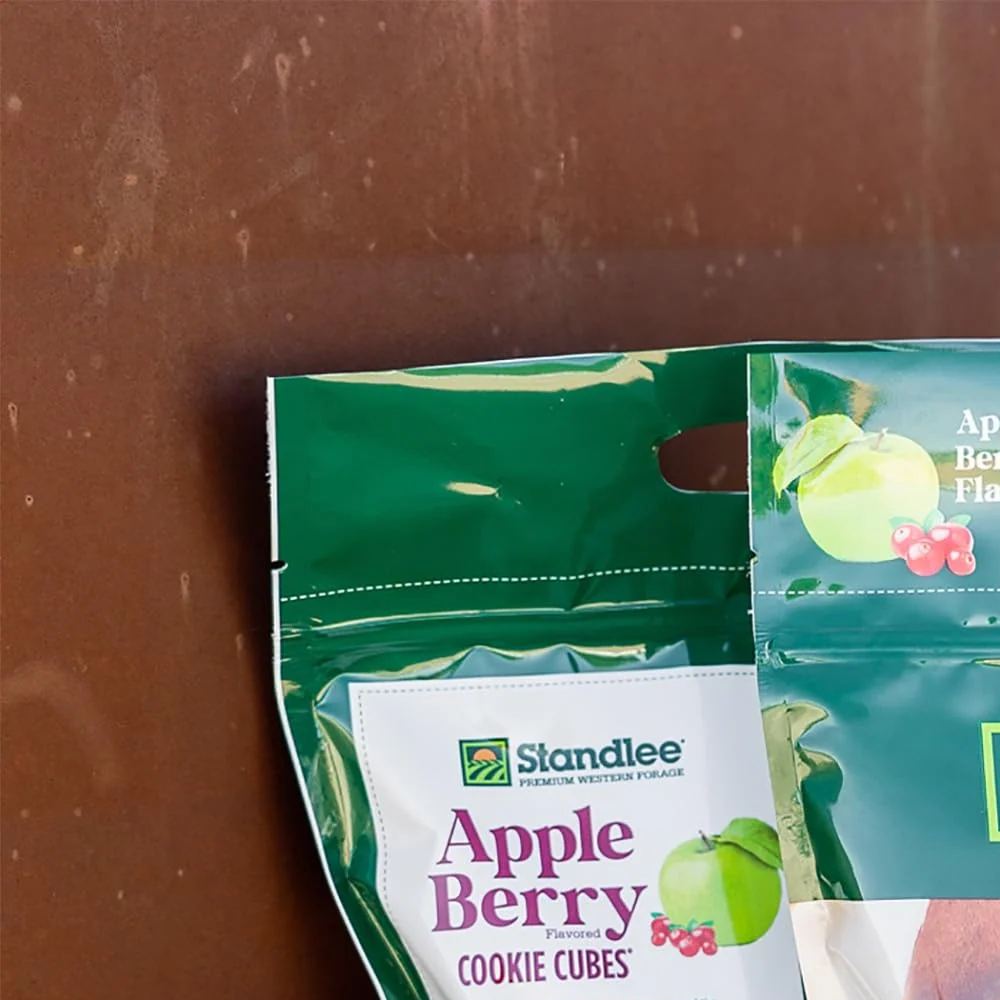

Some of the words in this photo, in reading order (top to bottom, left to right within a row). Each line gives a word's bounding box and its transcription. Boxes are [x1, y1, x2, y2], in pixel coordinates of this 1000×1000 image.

[519, 776, 576, 787] PREMIUM
[578, 772, 633, 784] WESTERN
[636, 768, 685, 781] FORAGE
[435, 805, 634, 879] Apple
[428, 872, 648, 941] Berry
[545, 927, 601, 940] Flavored
[458, 951, 546, 986] COOKIE
